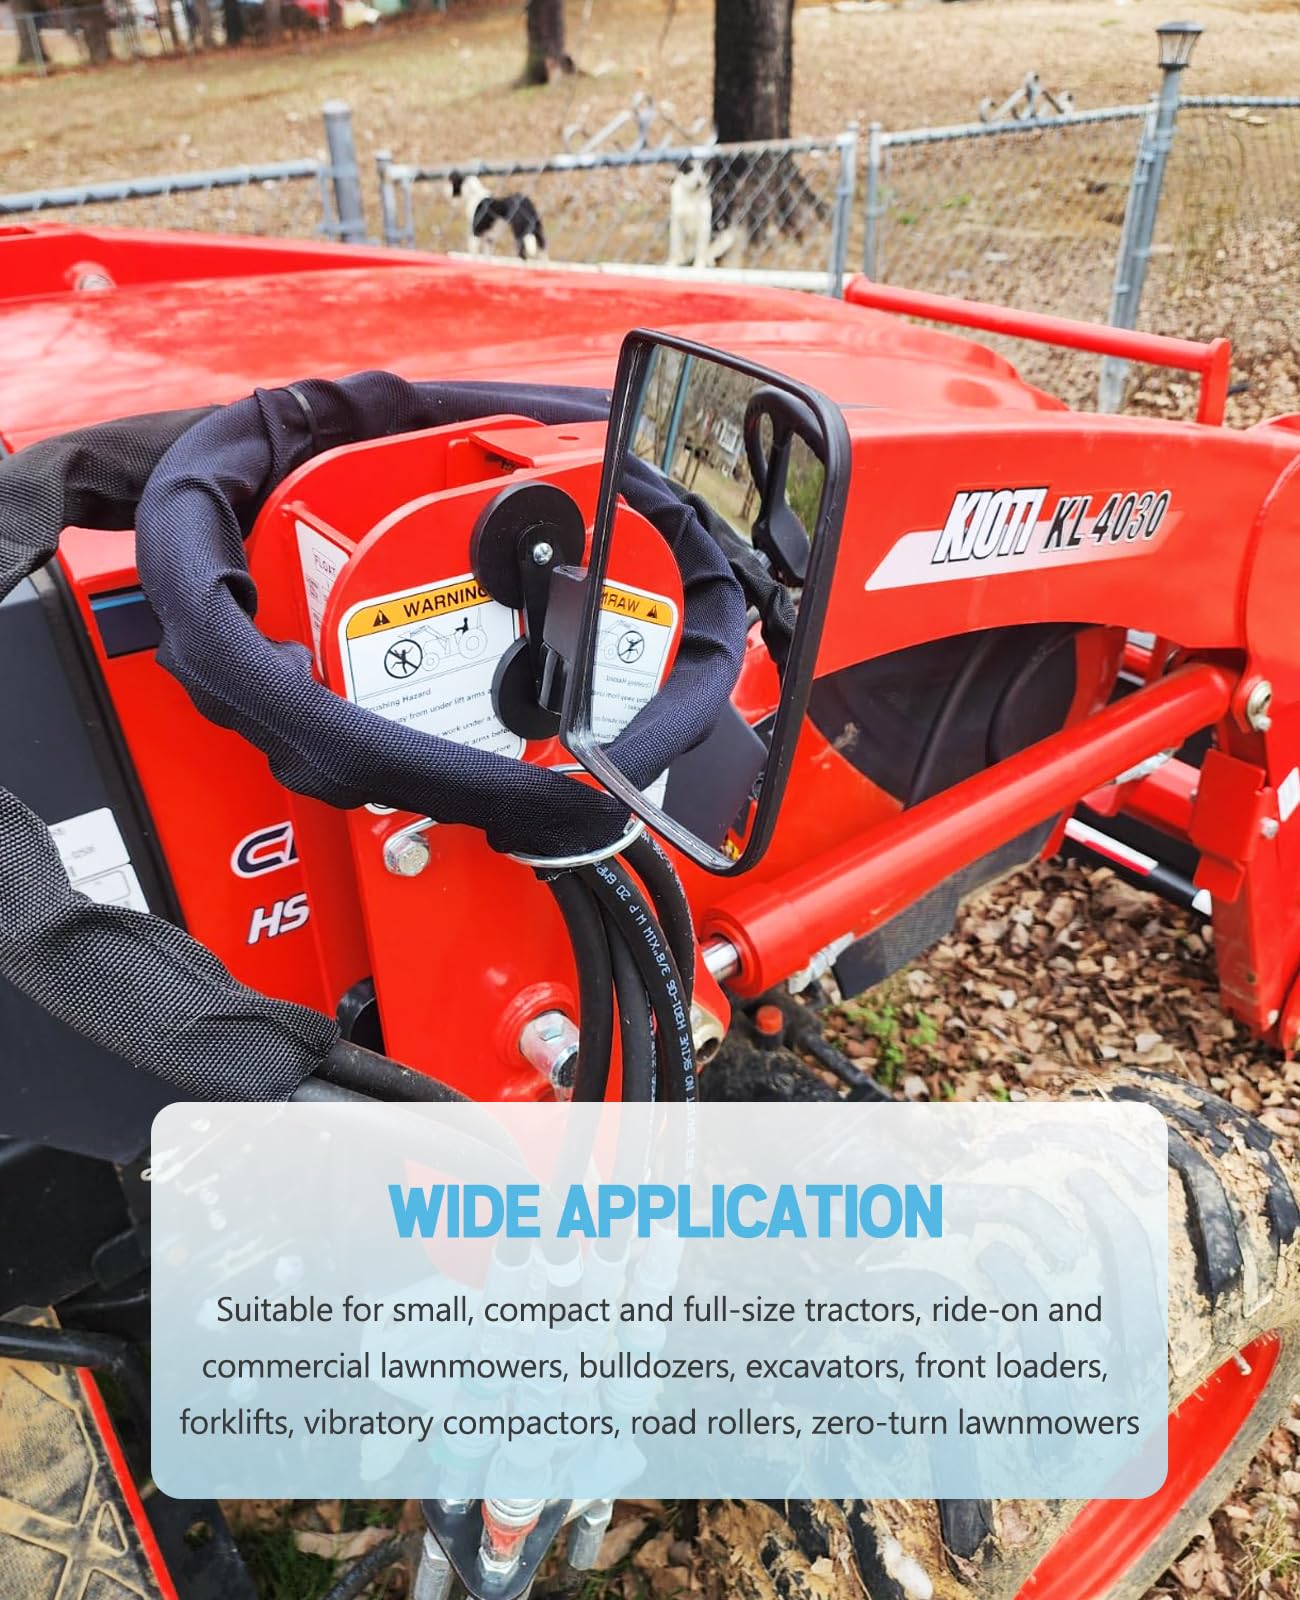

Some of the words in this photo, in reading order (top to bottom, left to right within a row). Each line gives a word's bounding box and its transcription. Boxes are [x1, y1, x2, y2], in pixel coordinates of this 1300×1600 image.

[931, 486, 1049, 565] KIOTI
[1090, 490, 1170, 545] 4030
[402, 688, 431, 702] Hazard
[409, 709, 428, 719] from
[430, 701, 453, 713] under
[442, 725, 461, 736] work
[463, 718, 485, 729] under
[680, 1032, 693, 1071] SKIVE
